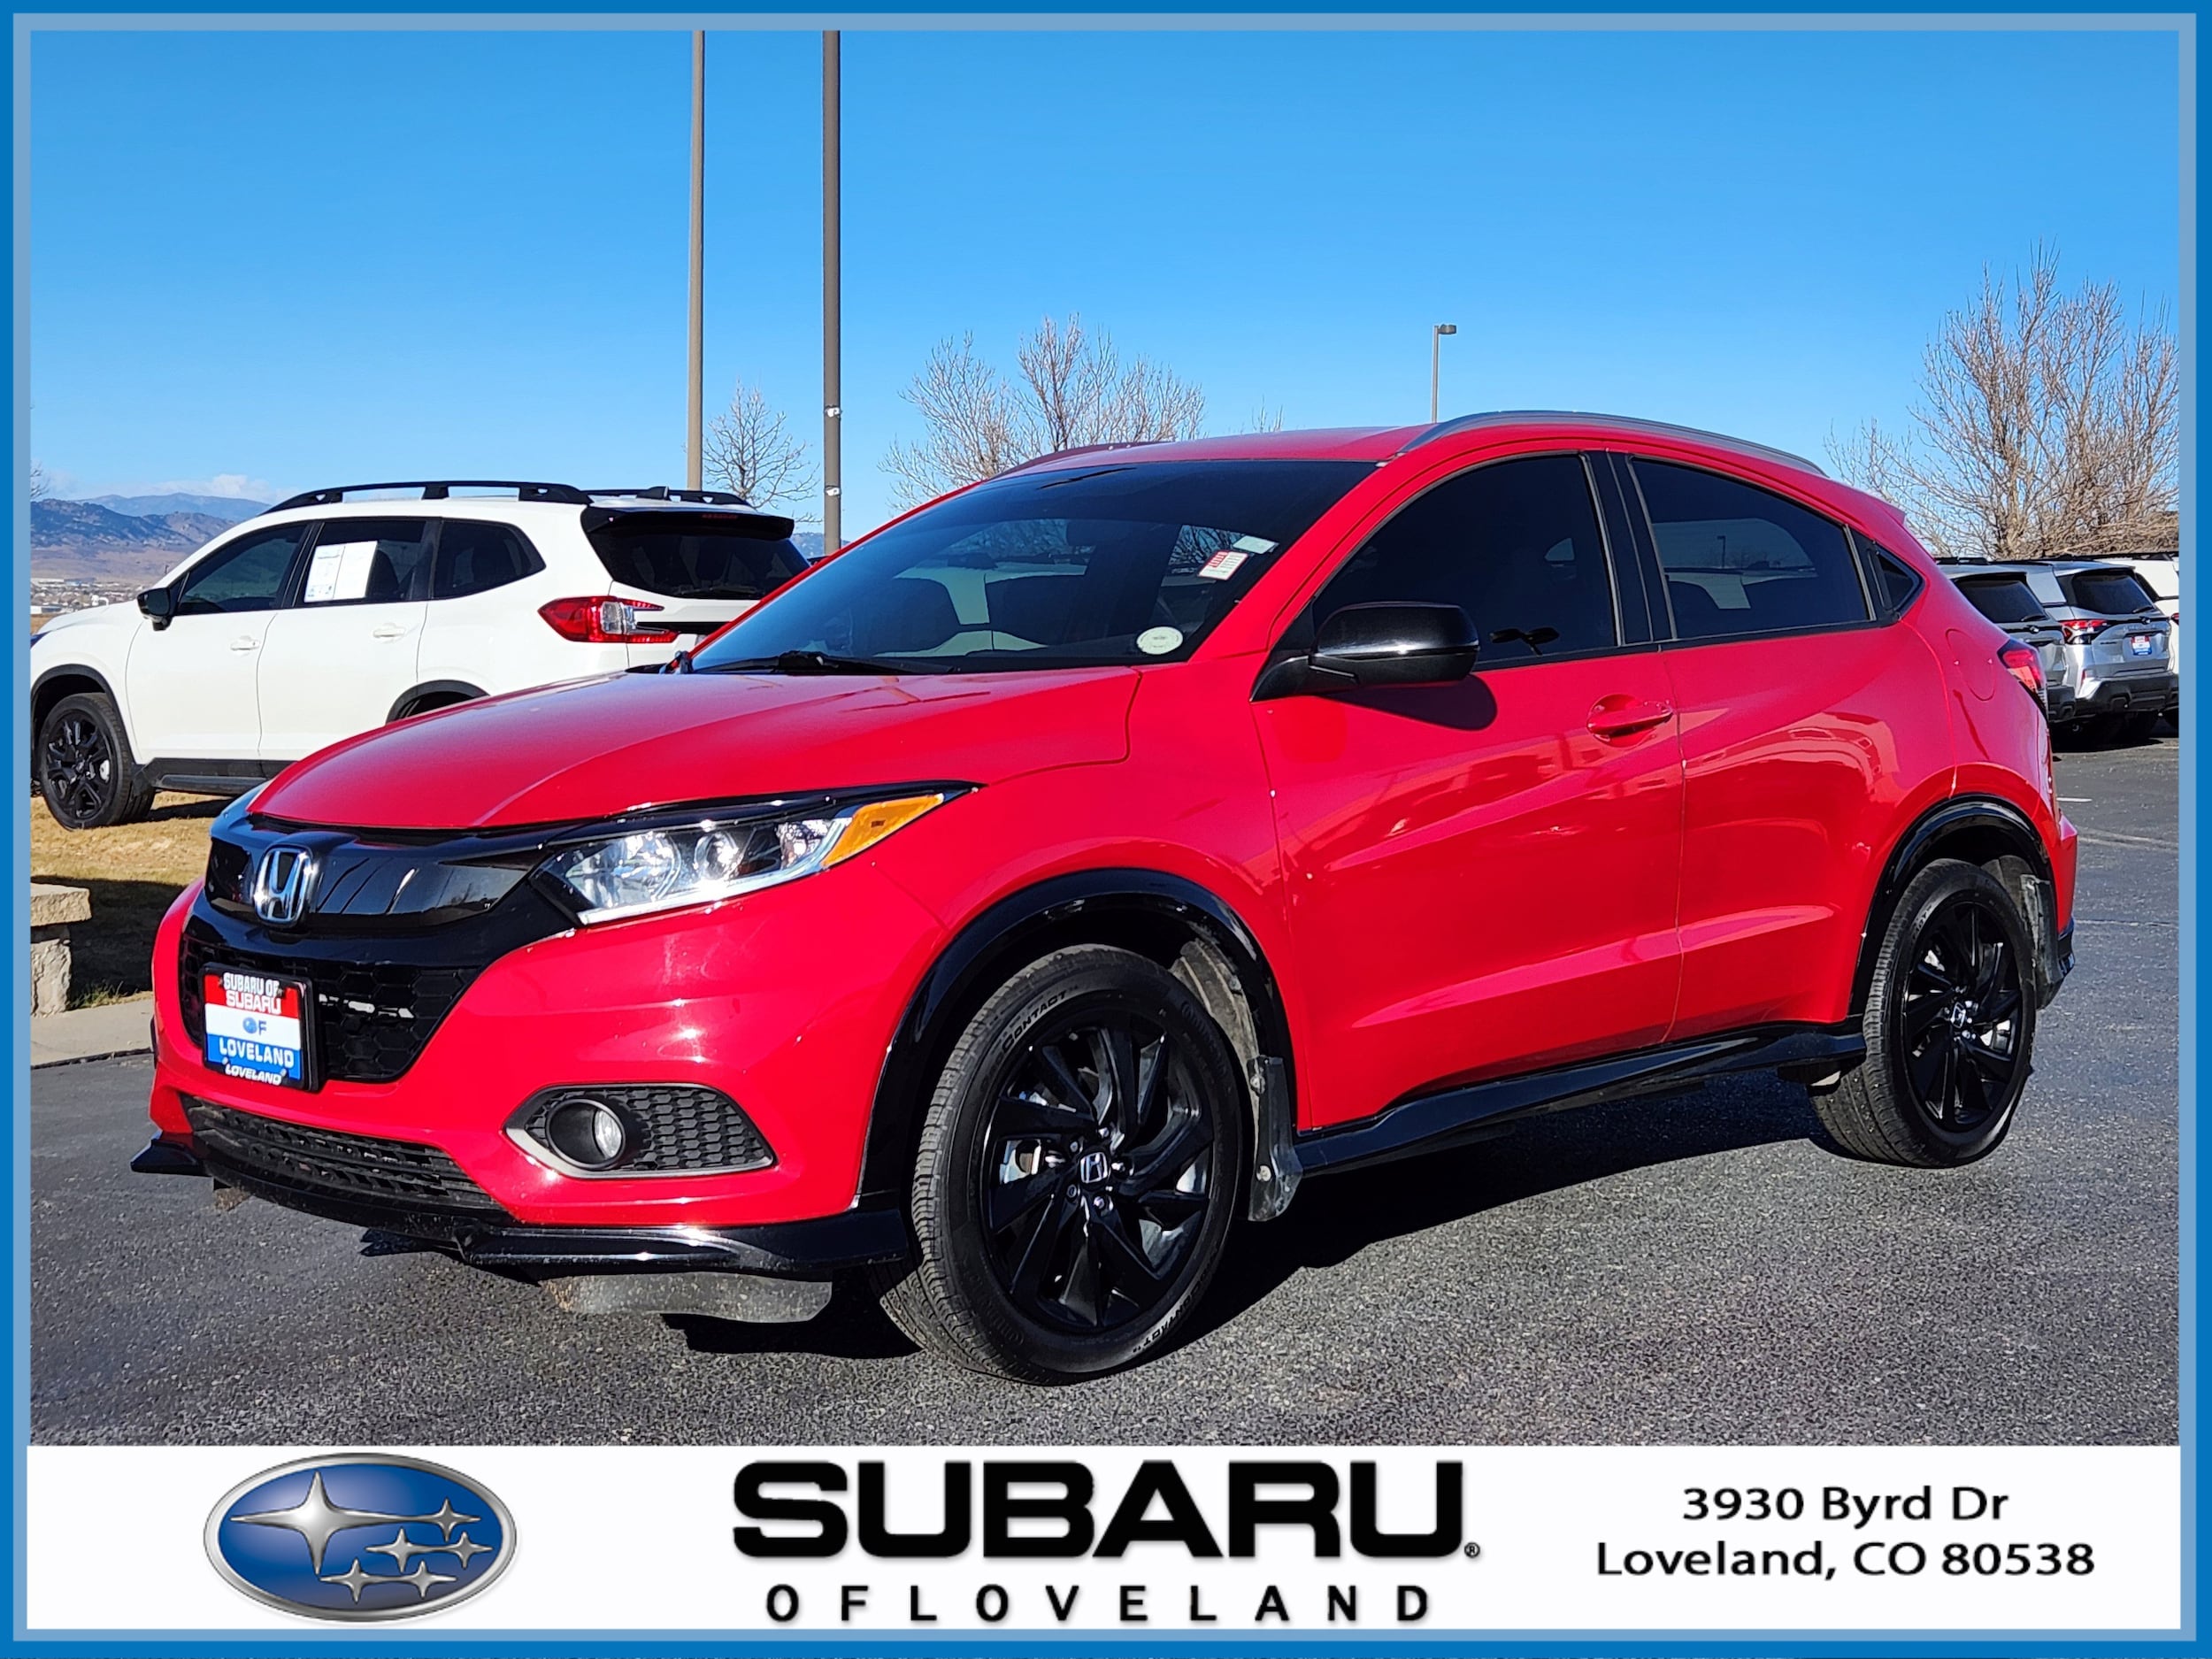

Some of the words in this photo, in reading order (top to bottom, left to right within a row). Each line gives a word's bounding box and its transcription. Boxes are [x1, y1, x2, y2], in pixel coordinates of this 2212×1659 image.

[223, 972, 265, 995] SUBARU
[265, 979, 280, 996] OF
[226, 989, 281, 1015] SUBARU
[1002, 989, 1067, 1054] CONTACT
[219, 1036, 295, 1069] LOVELAND
[225, 1064, 282, 1086] LOVELAND
